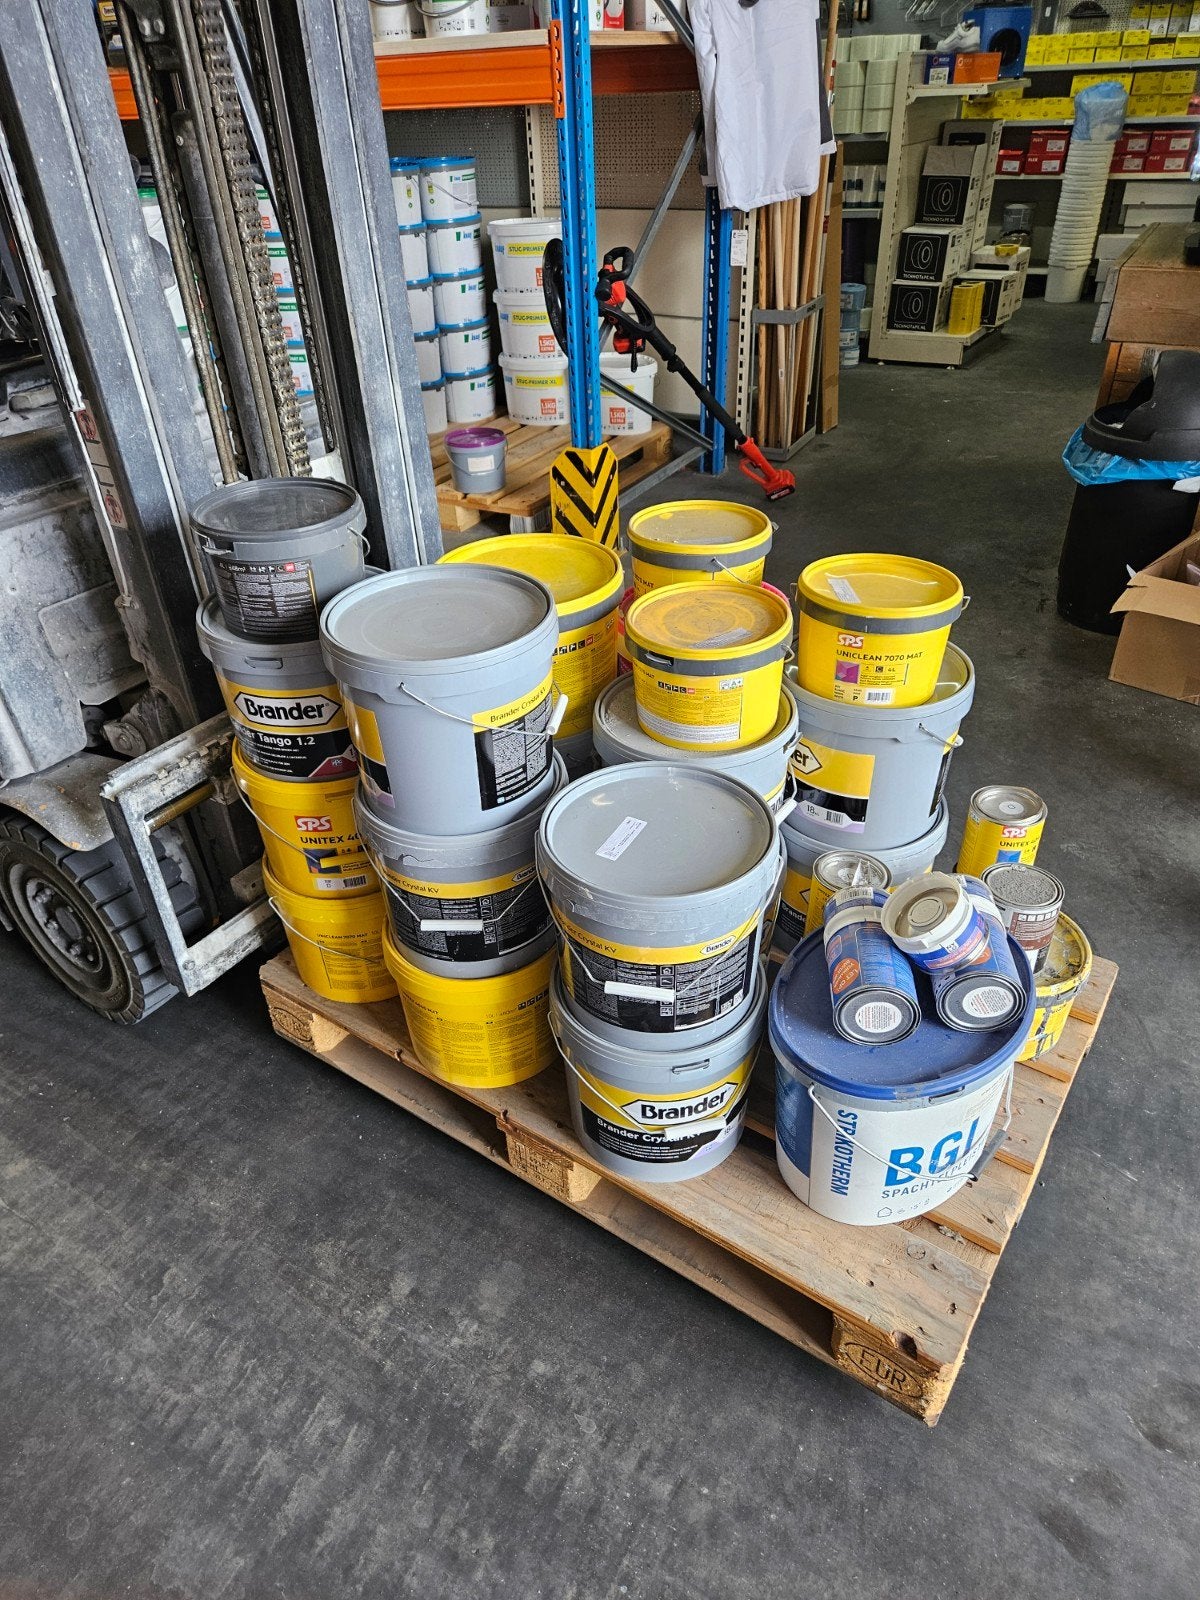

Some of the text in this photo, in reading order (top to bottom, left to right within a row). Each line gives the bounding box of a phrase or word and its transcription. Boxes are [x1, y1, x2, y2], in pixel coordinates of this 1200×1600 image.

[838, 633, 865, 649] SPS
[836, 649, 924, 662] UNICLEAN 7070 MAT
[243, 697, 325, 721] Brander
[490, 707, 520, 723] Brander
[257, 732, 292, 747] Tango
[296, 736, 316, 746] 1.2
[806, 804, 815, 815] 18
[297, 816, 331, 831] SPS
[300, 835, 345, 845] UNITEX
[1002, 827, 1027, 838] SPS
[402, 880, 426, 891] Crystal
[577, 932, 603, 950] Crystal
[604, 945, 617, 953] KV
[706, 938, 732, 953] Brander
[640, 1090, 728, 1121] Brander
[597, 1117, 640, 1140] Brander
[860, 1349, 906, 1391] EUR
